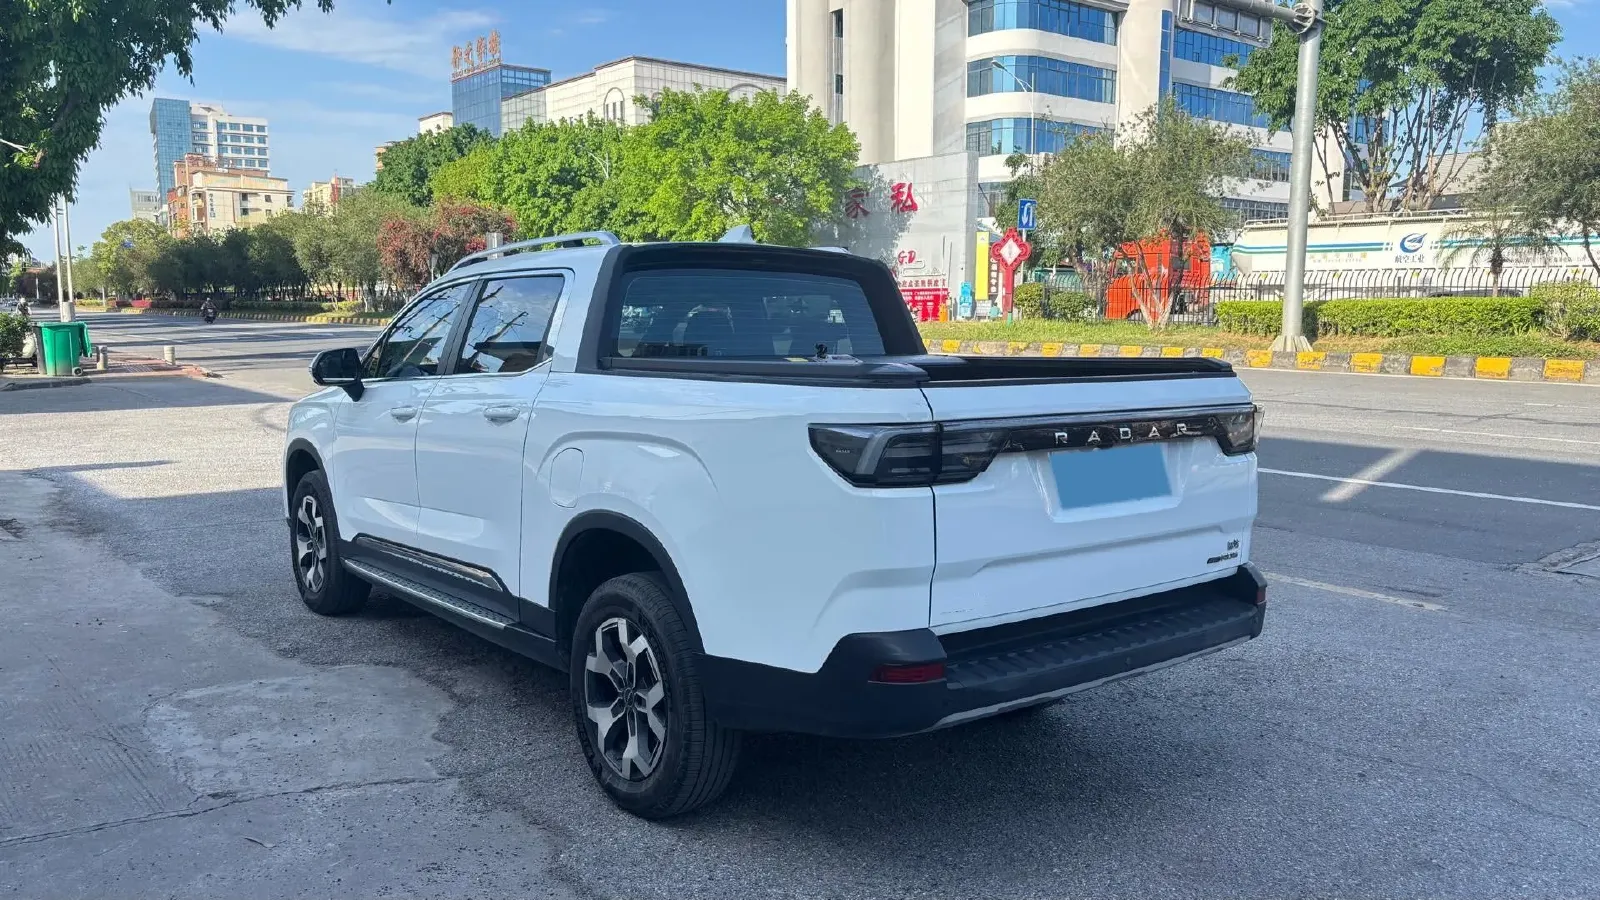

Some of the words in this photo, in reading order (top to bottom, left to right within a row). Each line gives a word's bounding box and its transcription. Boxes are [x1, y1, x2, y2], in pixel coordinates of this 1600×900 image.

[845, 182, 919, 219] 家私
[1394, 254, 1425, 264] 航空工业
[1055, 423, 1187, 444] RADAR
